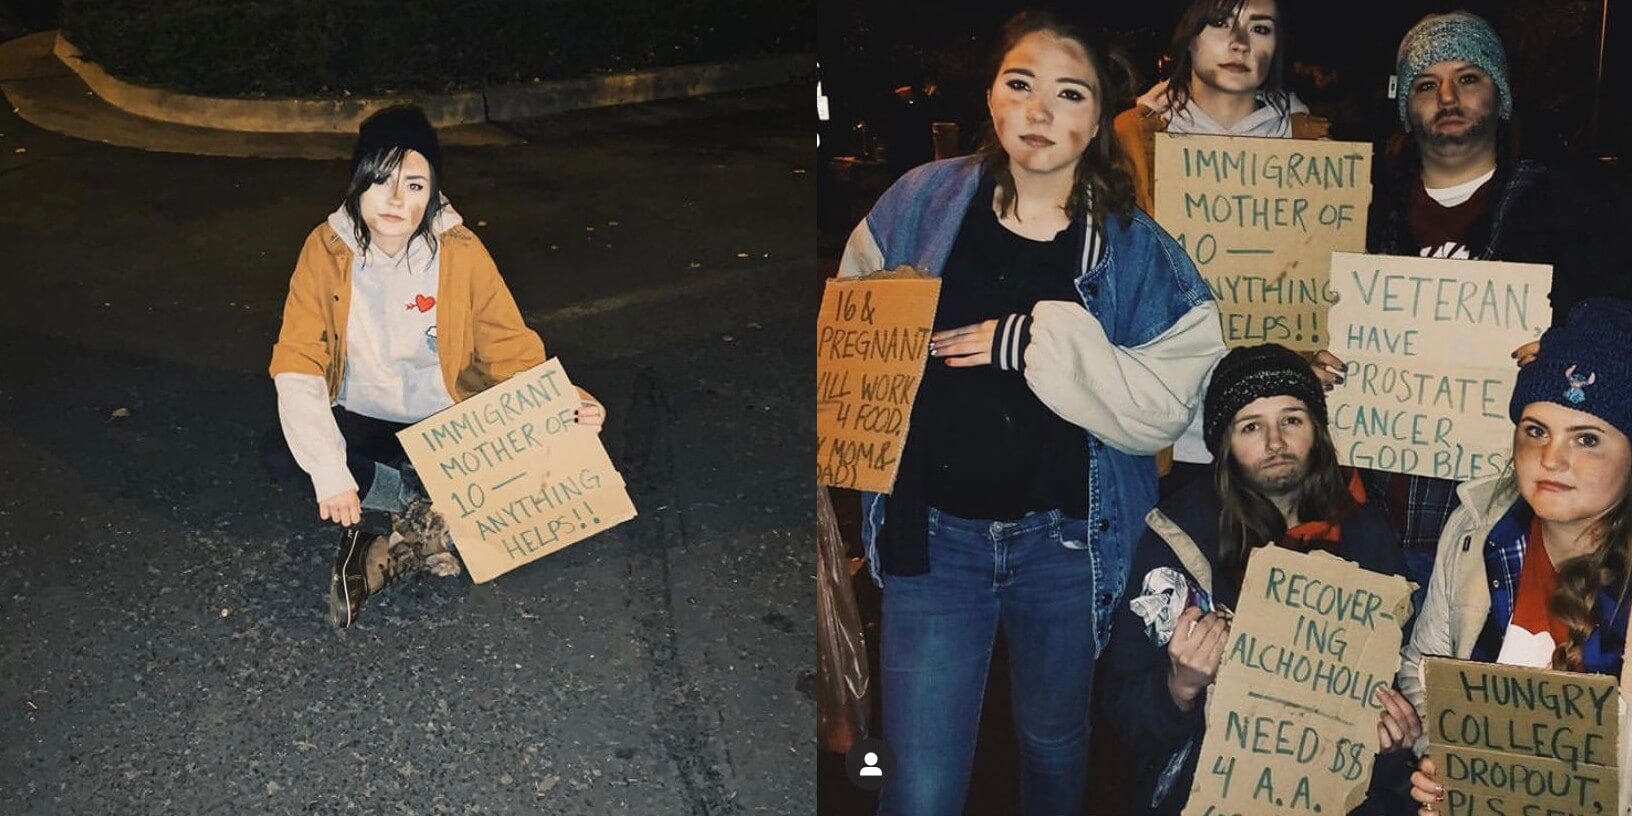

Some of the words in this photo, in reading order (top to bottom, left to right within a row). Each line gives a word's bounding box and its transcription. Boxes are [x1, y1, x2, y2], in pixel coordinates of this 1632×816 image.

[1183, 148, 1364, 190] IMMIGRANT
[1184, 192, 1309, 232] MOTHER
[1318, 204, 1355, 230] OF
[835, 290, 856, 322] 16
[861, 290, 875, 324] &
[1204, 275, 1338, 305] NYTHING
[1353, 270, 1542, 337] VETERAN,
[818, 326, 931, 363] PREGNANT
[1347, 324, 1418, 356] HAVE
[421, 370, 562, 452] IMMIGRANT
[861, 373, 917, 404] WORK
[1343, 361, 1505, 419] PROSTATE
[440, 422, 542, 480] MOTHER
[545, 408, 574, 435] OF
[836, 402, 851, 428] 4
[854, 404, 902, 436] FOOD.
[1350, 441, 1419, 473] GOD
[451, 483, 486, 519] 10
[475, 468, 601, 541] ANYTHING
[501, 502, 601, 559] HELPS!!
[1266, 567, 1394, 630] RECOVER-
[1293, 615, 1348, 662] ING
[1229, 632, 1388, 709] ALCHOHOLIC
[1460, 671, 1614, 726] HUNGRY
[1225, 710, 1320, 764] NEED
[1438, 709, 1607, 771] COLLEGE
[1212, 755, 1236, 798] 4
[1446, 753, 1603, 813] DROPOUT,
